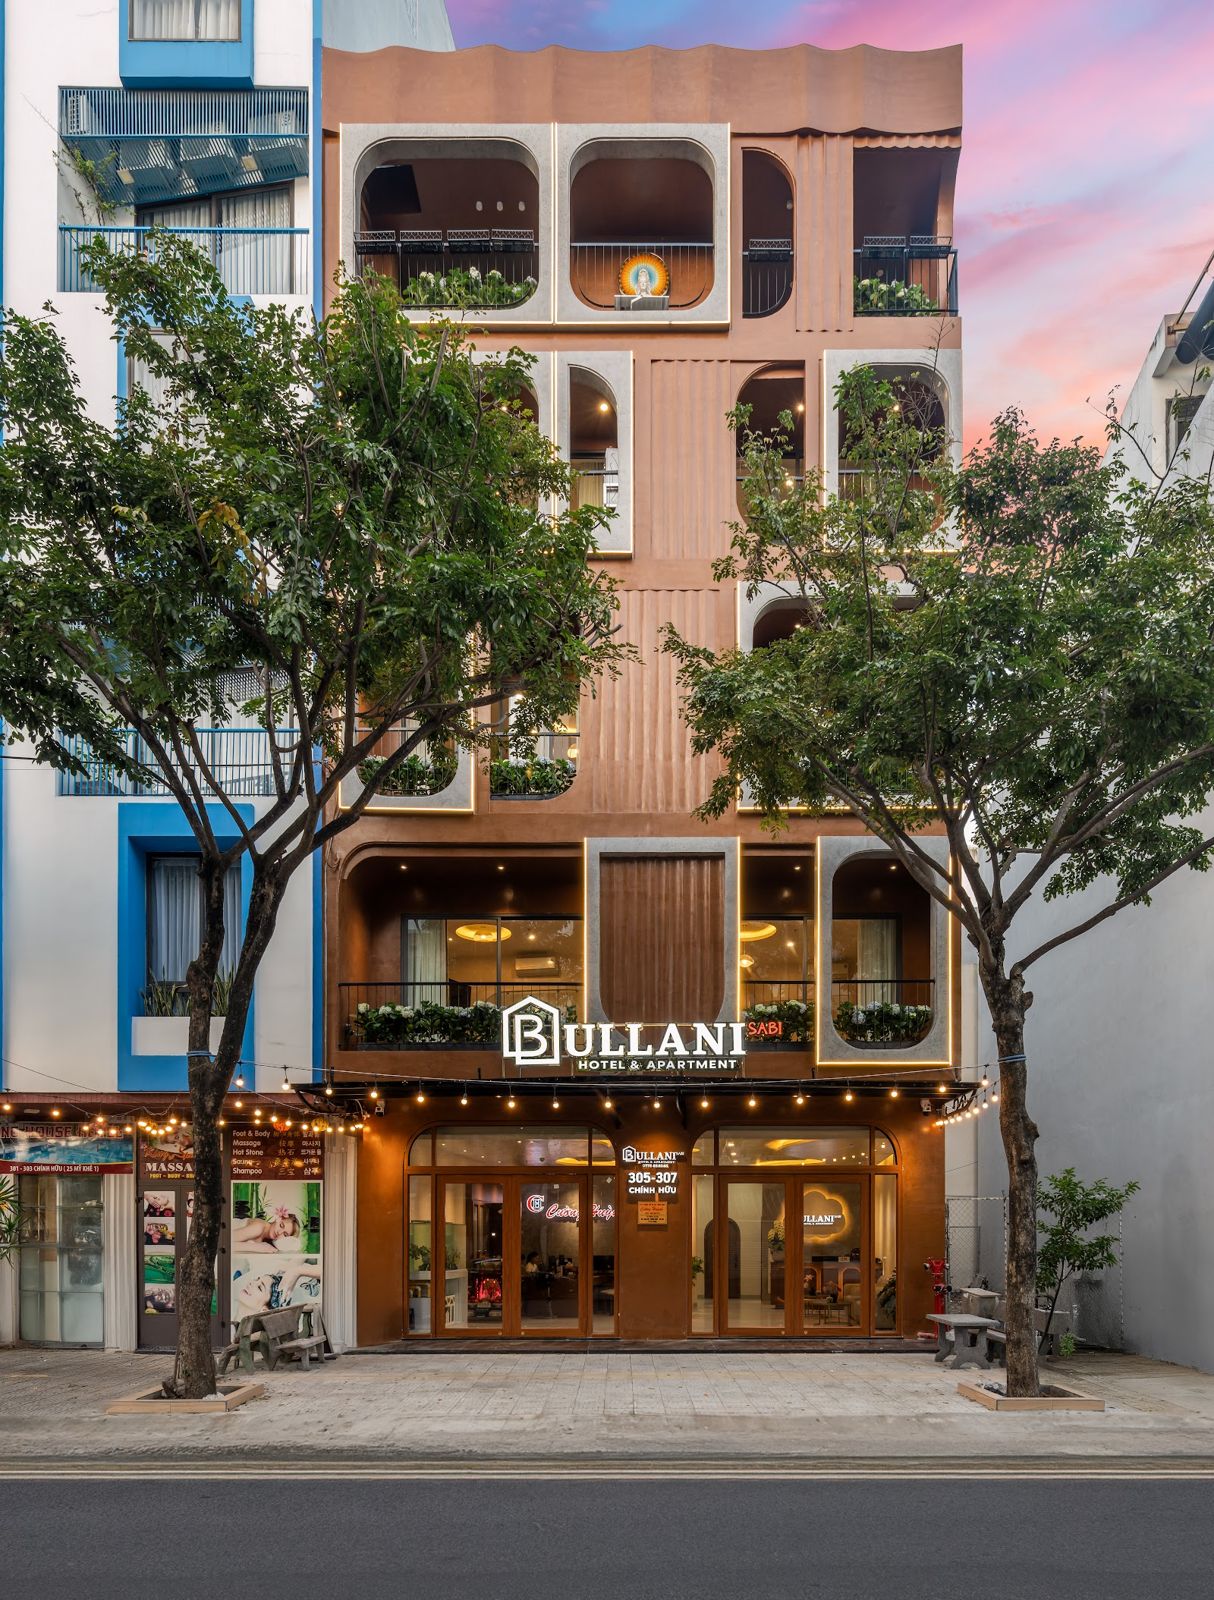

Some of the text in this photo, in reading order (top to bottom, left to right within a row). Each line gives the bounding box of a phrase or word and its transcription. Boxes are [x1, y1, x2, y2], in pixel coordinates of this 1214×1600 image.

[502, 995, 746, 1065] BULLANI
[748, 1021, 782, 1035] SABI
[578, 1060, 737, 1070] HOTEL & APARTMENT
[254, 1130, 271, 1138] Body
[622, 1145, 677, 1163] BULLANI
[145, 1162, 193, 1172] MASSA
[232, 1167, 262, 1175] Shampoo
[628, 1172, 678, 1184] 305-307
[628, 1184, 677, 1194] CHÍNH HỮU
